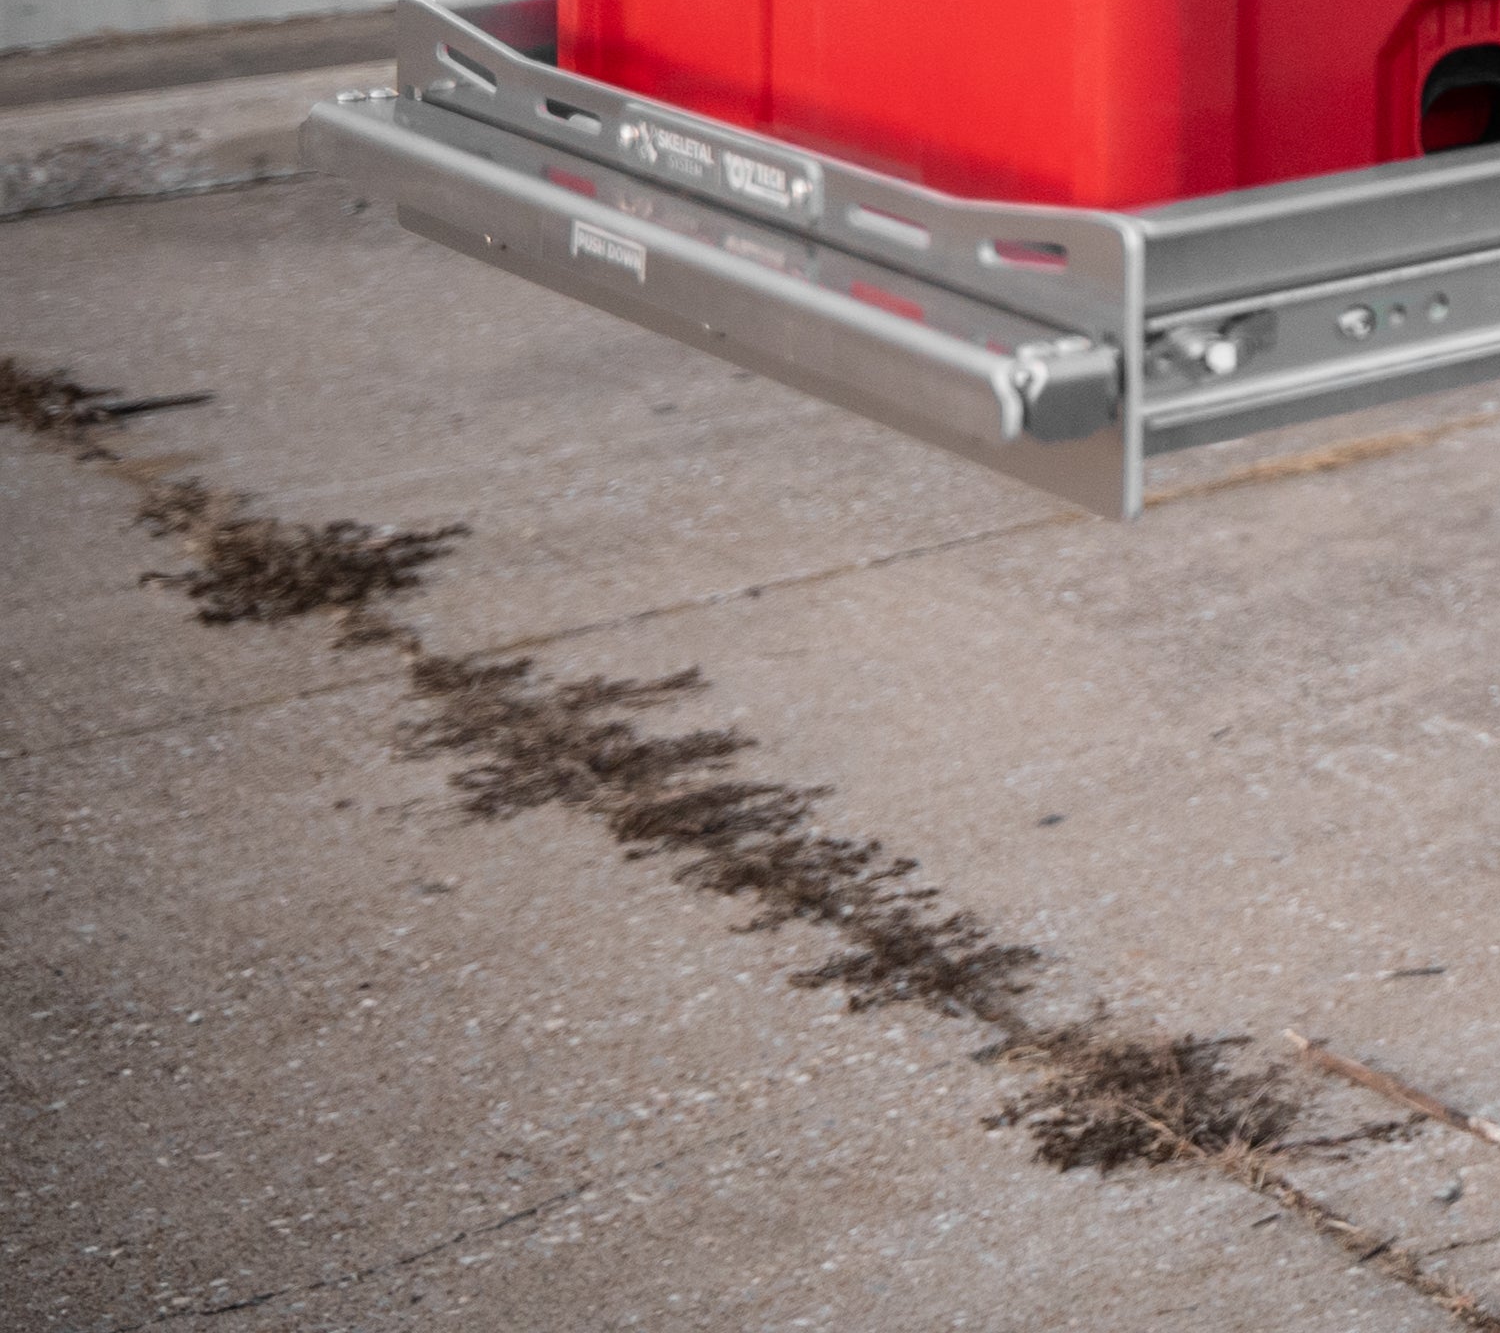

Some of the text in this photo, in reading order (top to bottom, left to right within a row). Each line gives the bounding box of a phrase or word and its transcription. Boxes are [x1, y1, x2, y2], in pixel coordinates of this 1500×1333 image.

[657, 128, 715, 165] SKELETAL
[669, 155, 704, 176] SYSTEM
[577, 230, 643, 271] PUSH DOWN
